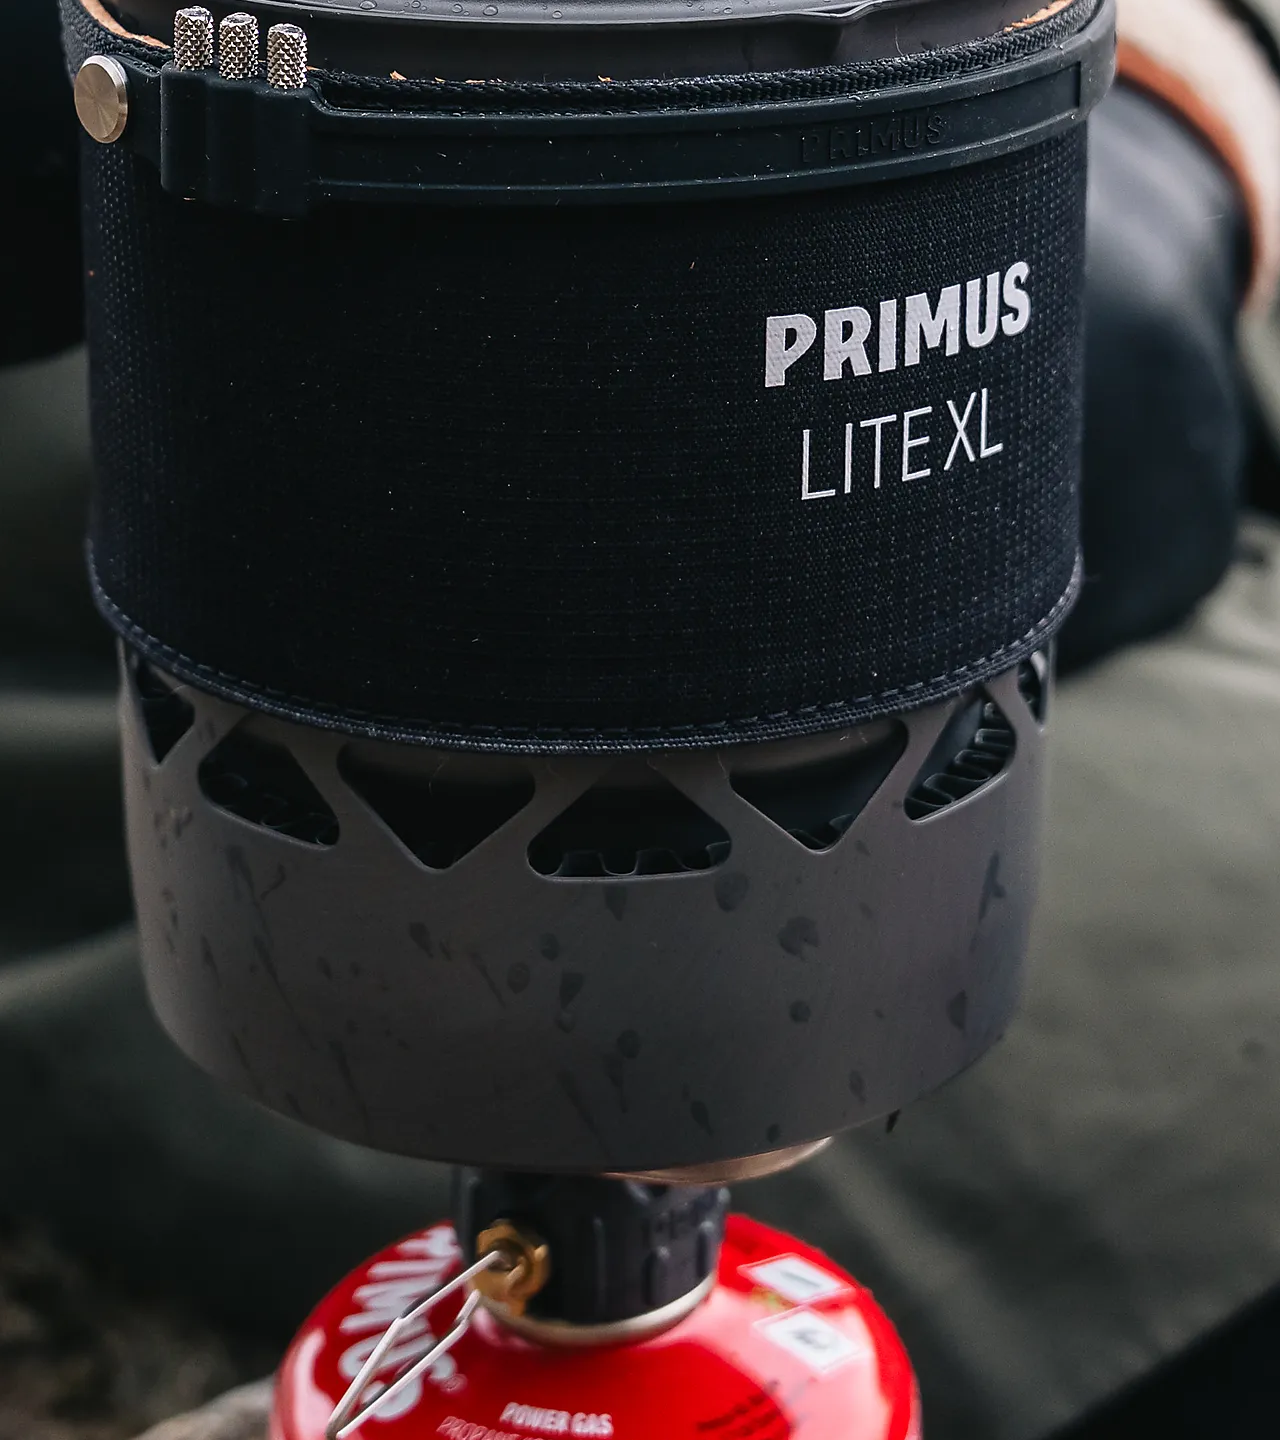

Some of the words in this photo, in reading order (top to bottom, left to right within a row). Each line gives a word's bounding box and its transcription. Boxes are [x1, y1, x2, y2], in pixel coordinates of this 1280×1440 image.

[765, 261, 1032, 388] PRIMUS
[801, 406, 933, 500] LITE
[943, 388, 1004, 471] XL
[499, 1402, 571, 1434] POWER
[570, 1412, 614, 1438] GAS
